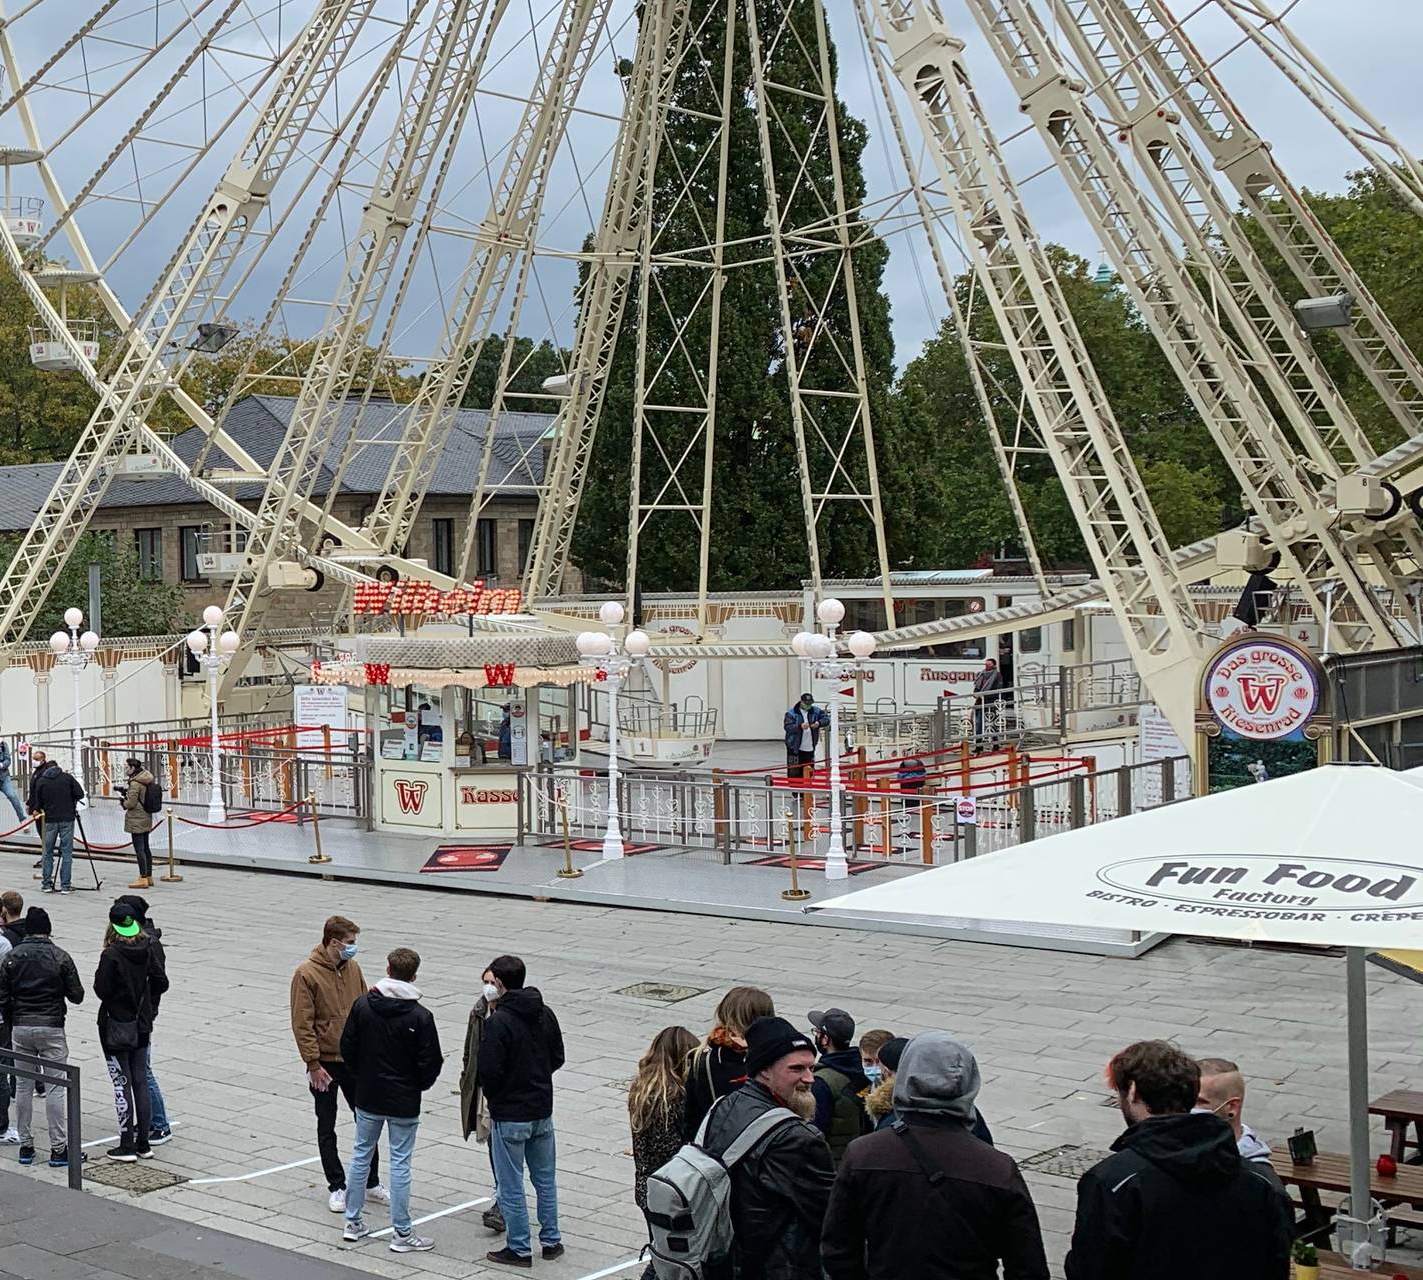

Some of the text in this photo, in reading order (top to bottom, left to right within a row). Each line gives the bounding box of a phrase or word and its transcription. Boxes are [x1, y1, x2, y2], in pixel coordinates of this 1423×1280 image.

[354, 580, 521, 614] Wilhelm
[1217, 651, 1302, 681] Das grosse
[1237, 674, 1288, 714] W
[1220, 703, 1302, 734] Riesenrad
[394, 779, 428, 815] W
[1145, 862, 1417, 901] Fun Food
[1212, 888, 1319, 906] Factory
[1085, 890, 1158, 908] BISTRO
[1174, 903, 1327, 922] ESPRESSOBAR
